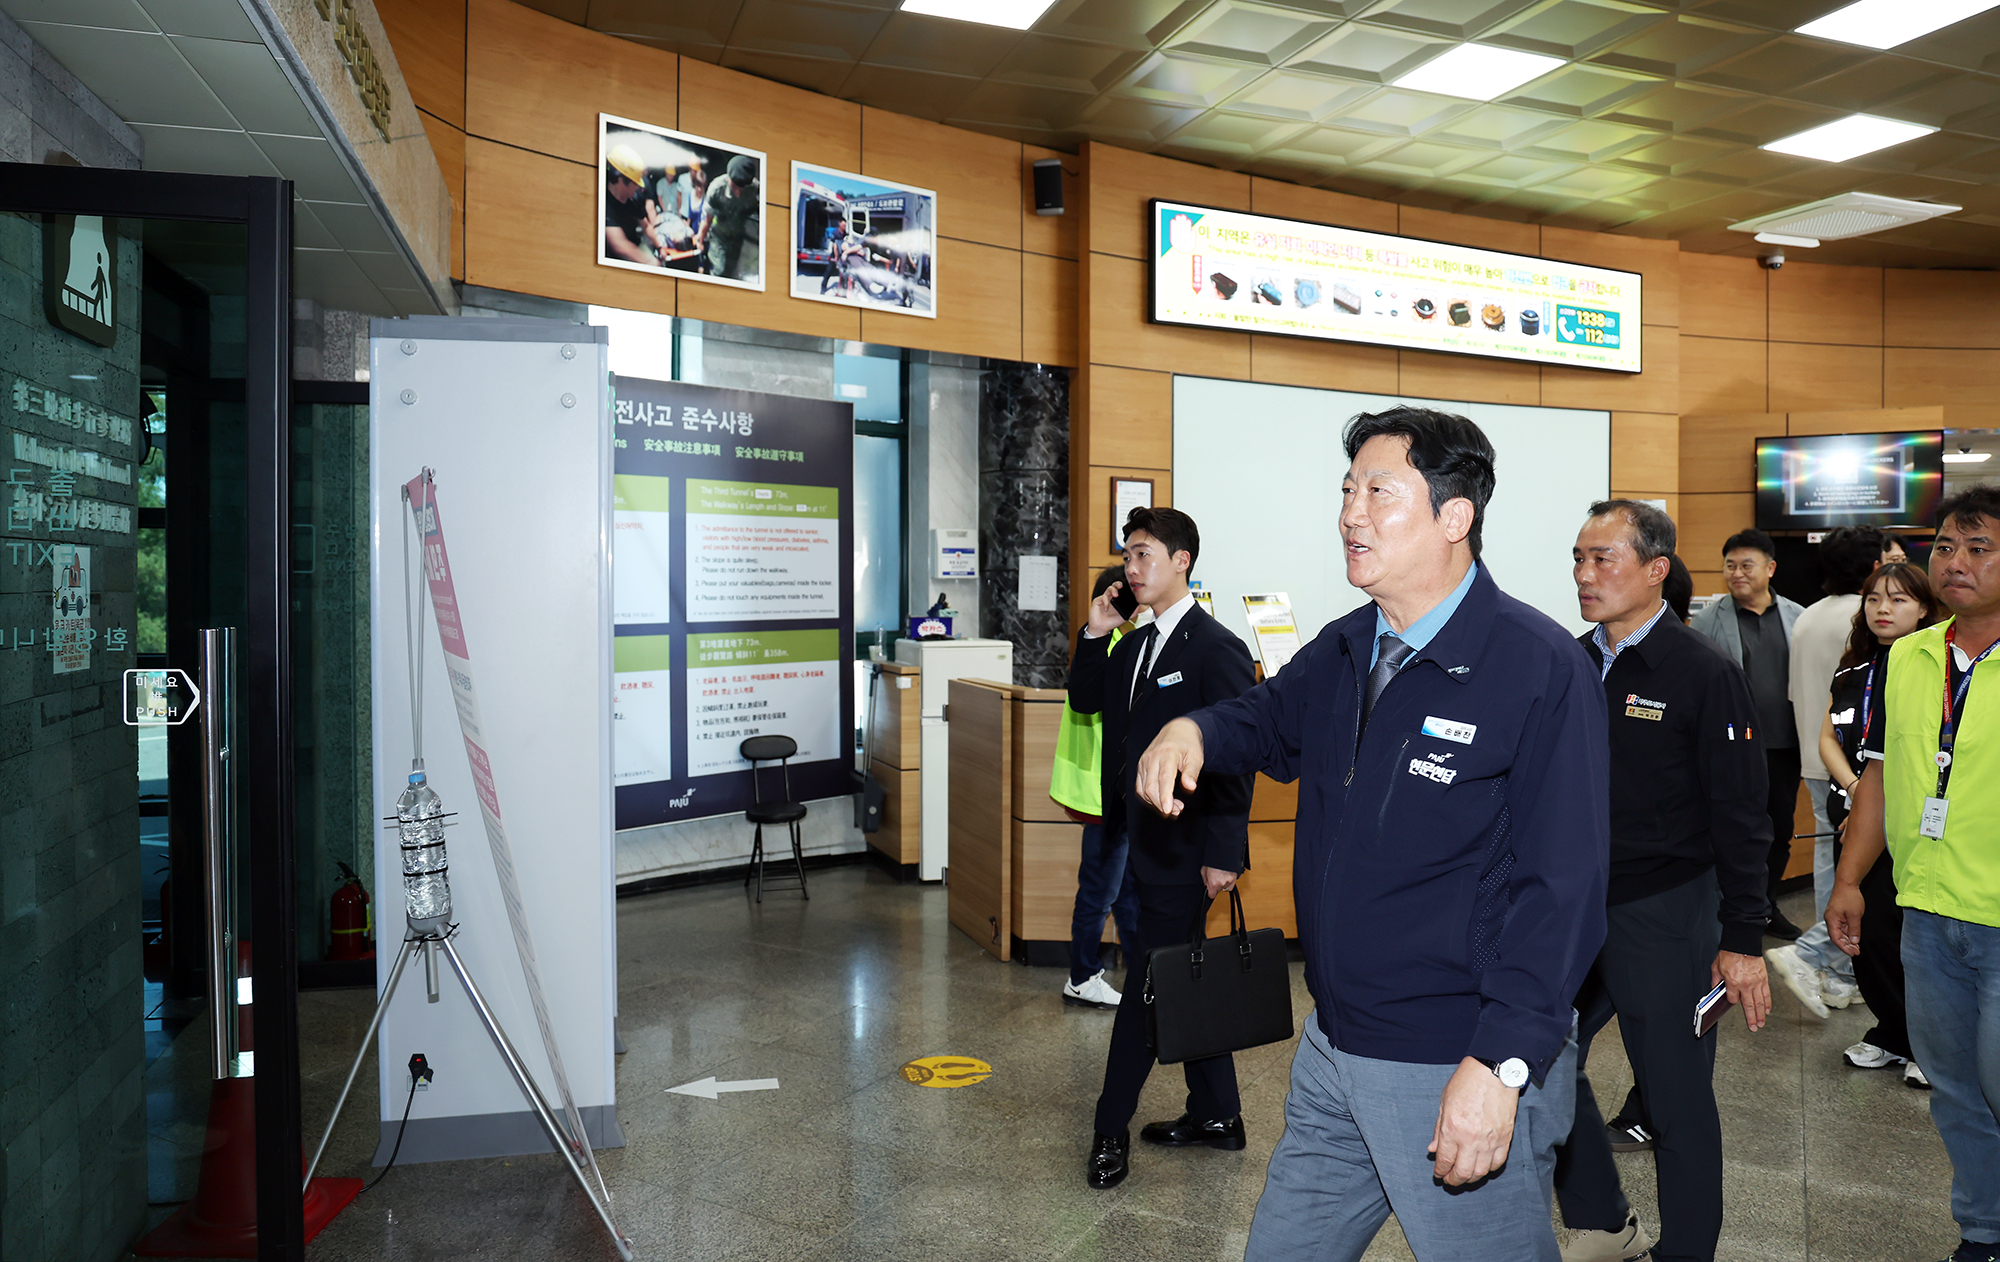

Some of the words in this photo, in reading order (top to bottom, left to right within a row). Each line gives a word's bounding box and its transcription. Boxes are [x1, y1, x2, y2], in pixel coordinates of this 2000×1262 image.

[1198, 225, 1209, 239] 이
[1217, 228, 1250, 245] 지역은
[1253, 231, 1277, 250] 유실
[1341, 244, 1362, 262] 지뢰
[1365, 249, 1375, 262] 등
[1410, 256, 1429, 269] 사고
[1433, 258, 1461, 274] 위험이
[1463, 263, 1482, 277] 매우
[1485, 266, 1503, 280] 높아
[1208, 244, 1222, 253] This
[1225, 248, 1241, 256] area
[1576, 310, 1606, 328] 1338
[1584, 327, 1604, 344] 112
[615, 400, 673, 427] 전사고
[682, 406, 754, 436] 준수사항
[644, 438, 721, 457] 安全事故注意事項
[701, 486, 713, 495] The
[714, 487, 729, 496] Third
[701, 500, 712, 508] The
[745, 502, 765, 511] Length
[766, 503, 777, 511] and
[136, 676, 178, 688] 미세요
[136, 706, 177, 717] PUSH
[1427, 752, 1446, 763] PAJU
[1408, 758, 1457, 785] 현문현답
[669, 797, 690, 808] PAJU
